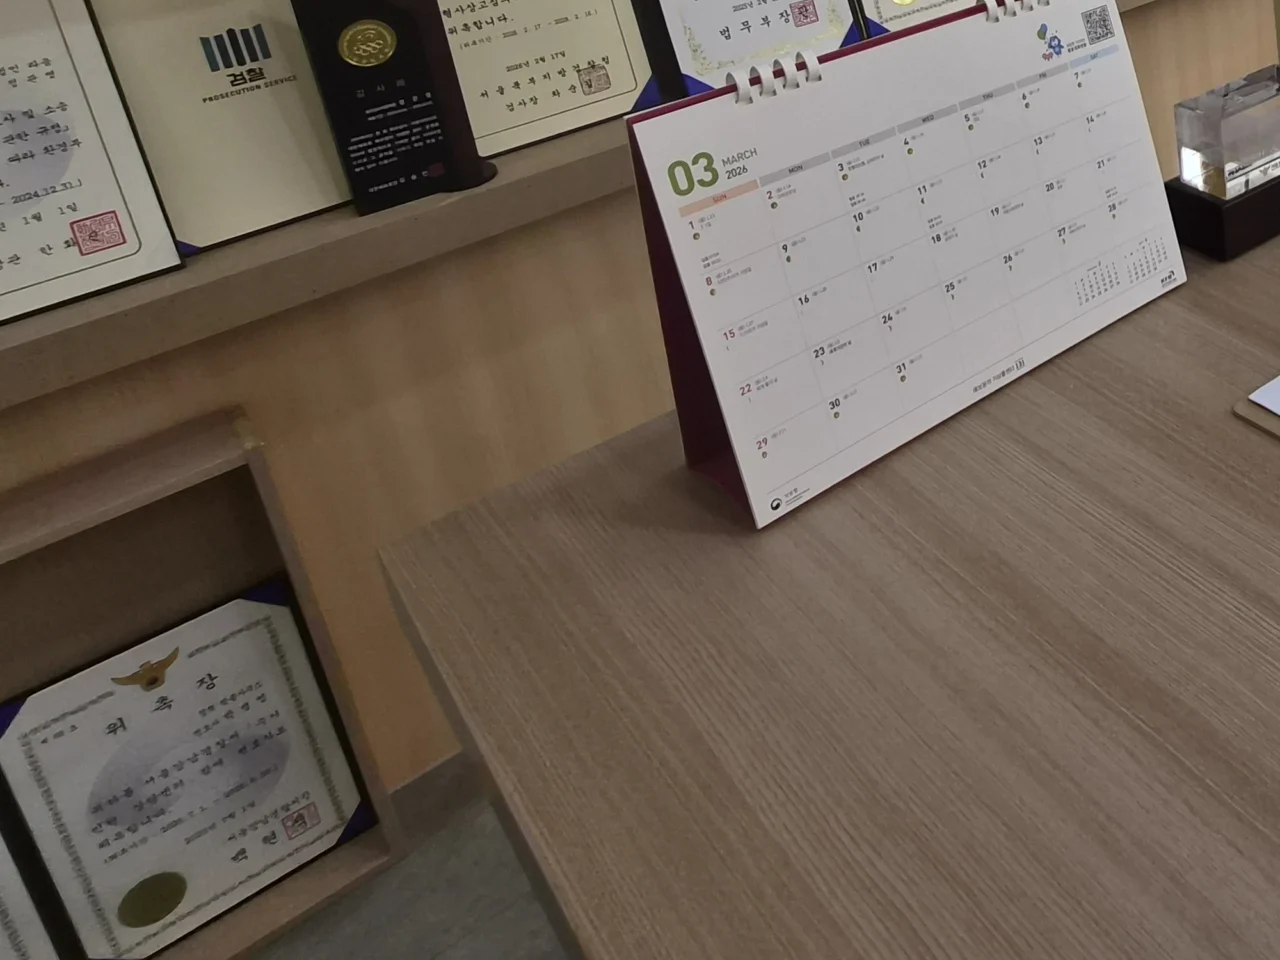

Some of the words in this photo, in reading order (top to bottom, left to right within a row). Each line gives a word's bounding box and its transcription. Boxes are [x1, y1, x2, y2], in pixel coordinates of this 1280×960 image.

[447, 13, 515, 37] 위촉합니다.
[226, 66, 267, 88] 검찰
[1073, 71, 1080, 81] 7
[202, 83, 263, 105] PROSECUTION
[263, 73, 299, 91] SERVICE
[1021, 92, 1027, 101] 6
[963, 113, 971, 123] 5
[1085, 115, 1096, 125] 14
[903, 137, 910, 146] 4
[1033, 136, 1043, 146] 13
[721, 147, 758, 168] MARCH
[837, 162, 845, 172] 3
[976, 159, 988, 171] 12
[1096, 158, 1106, 170] 21
[667, 151, 720, 197] 03
[725, 165, 749, 180] 2026
[917, 184, 928, 196] 11
[1045, 181, 1055, 192] 20
[766, 190, 774, 200] 2
[989, 206, 1001, 217] 19
[1107, 202, 1117, 213] 28
[852, 211, 864, 223] 10
[688, 220, 695, 230] 1
[1056, 226, 1067, 238] 27
[930, 233, 942, 245] 18
[781, 243, 789, 253] 9
[1002, 253, 1013, 265] 26
[867, 262, 878, 274] 17
[705, 276, 713, 287] 8
[944, 281, 956, 294] 25
[798, 294, 810, 306] 16
[881, 312, 894, 325] 24
[722, 328, 736, 341] 15
[813, 346, 826, 359] 23
[895, 362, 907, 374] 31
[739, 383, 753, 396] 22
[828, 397, 841, 410] 30
[755, 437, 769, 450] 29
